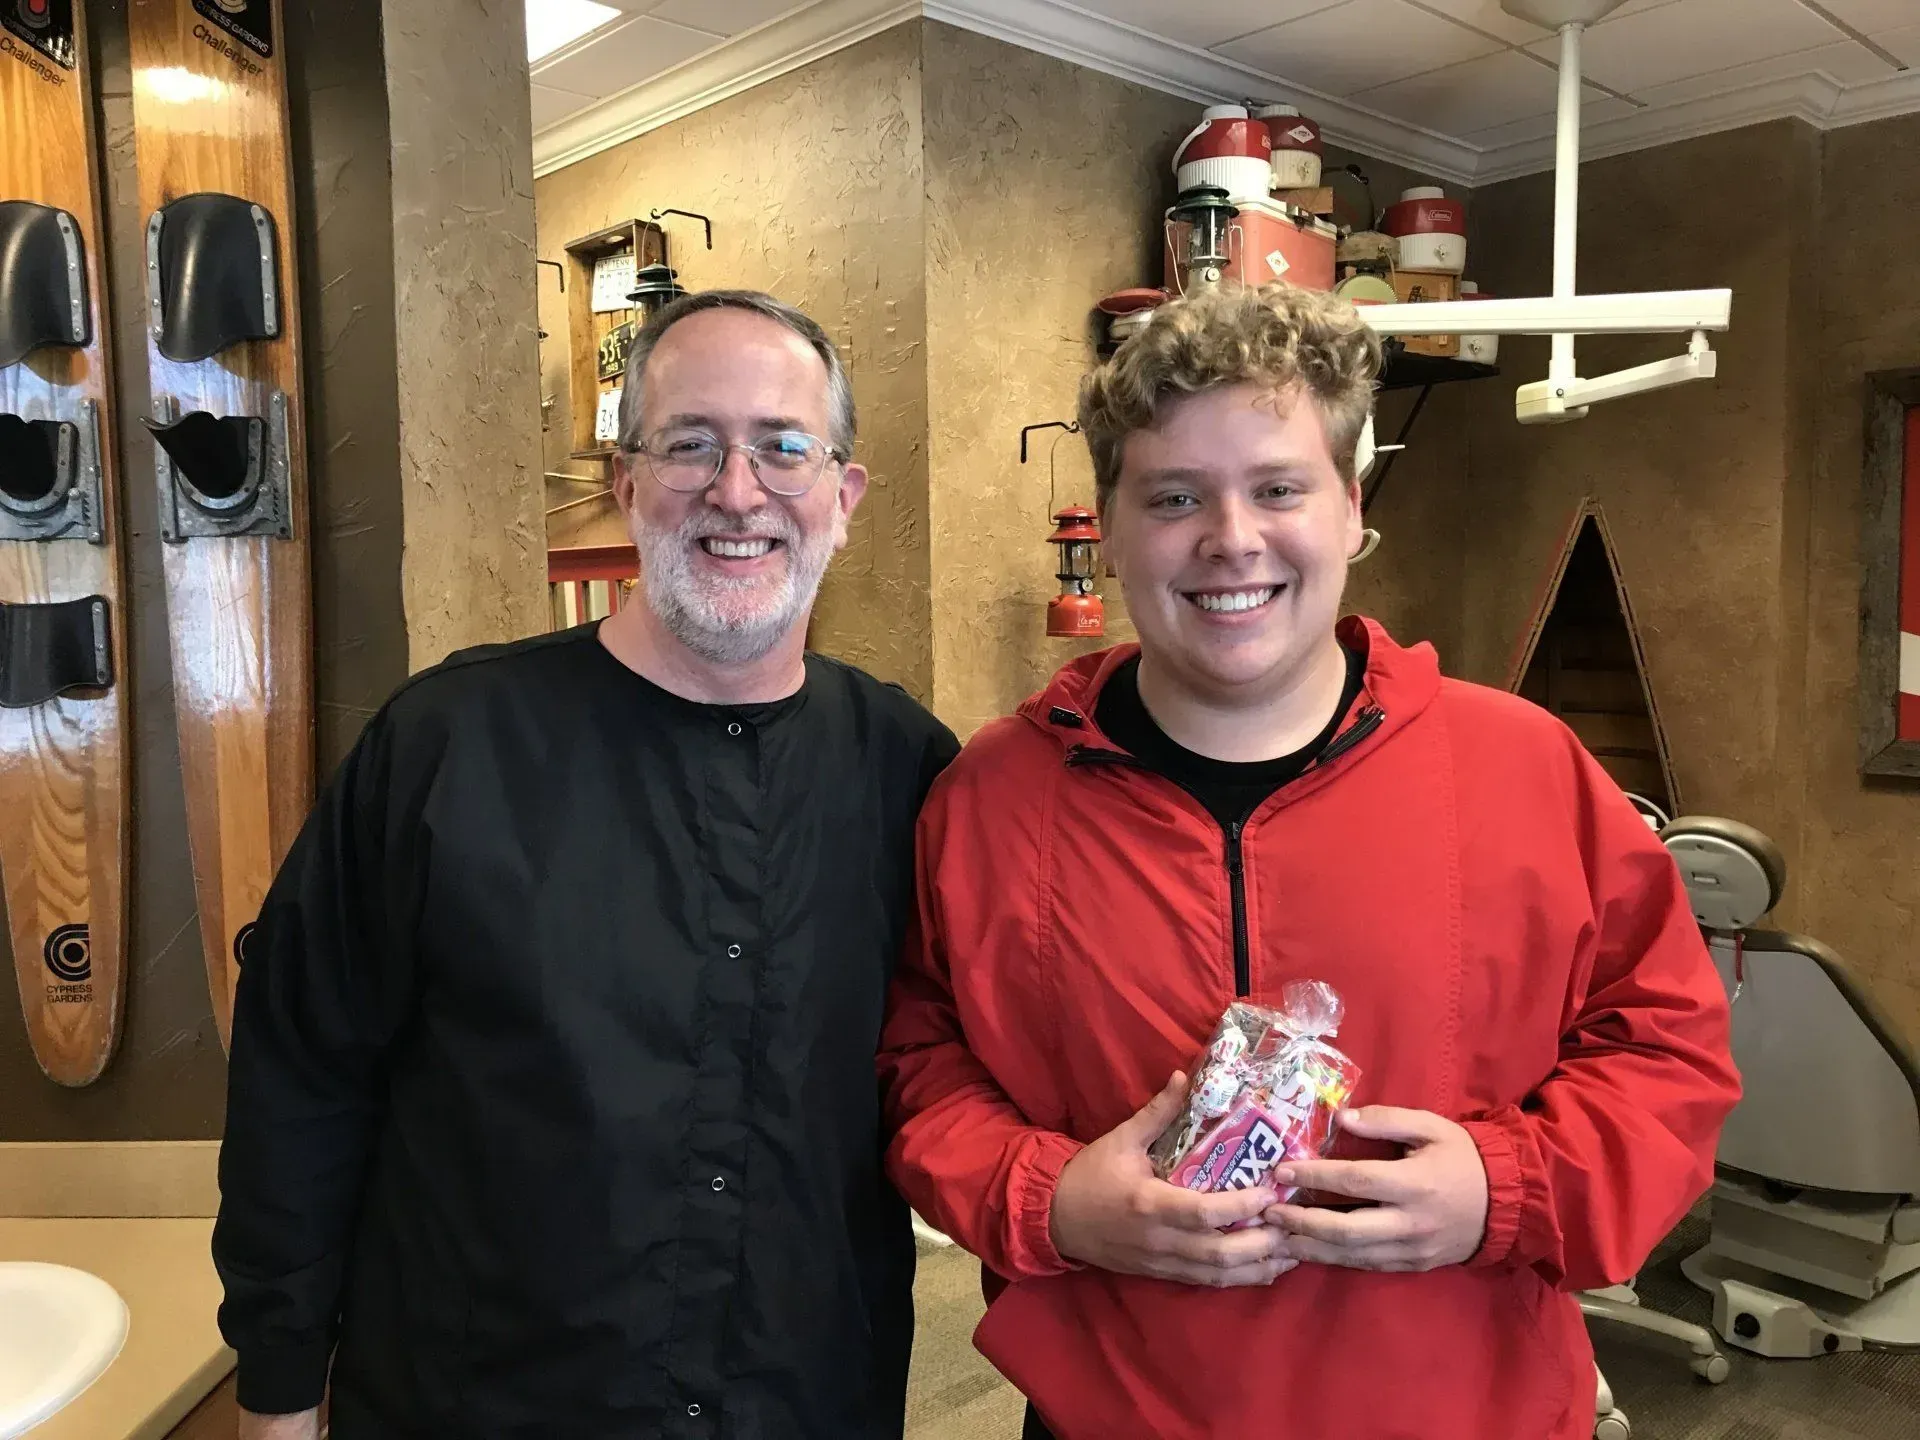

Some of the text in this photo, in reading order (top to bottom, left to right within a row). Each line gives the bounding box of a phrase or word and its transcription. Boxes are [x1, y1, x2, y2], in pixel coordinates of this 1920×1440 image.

[192, 24, 263, 76] Challenger
[231, 23, 269, 53] GARDENS
[0, 37, 66, 87] Challenger
[47, 984, 93, 993] CYPRESS
[47, 993, 93, 1003] GARDENS
[1188, 1142, 1225, 1191] CLASSIC BUBB
[1221, 1155, 1239, 1179] LASTING
